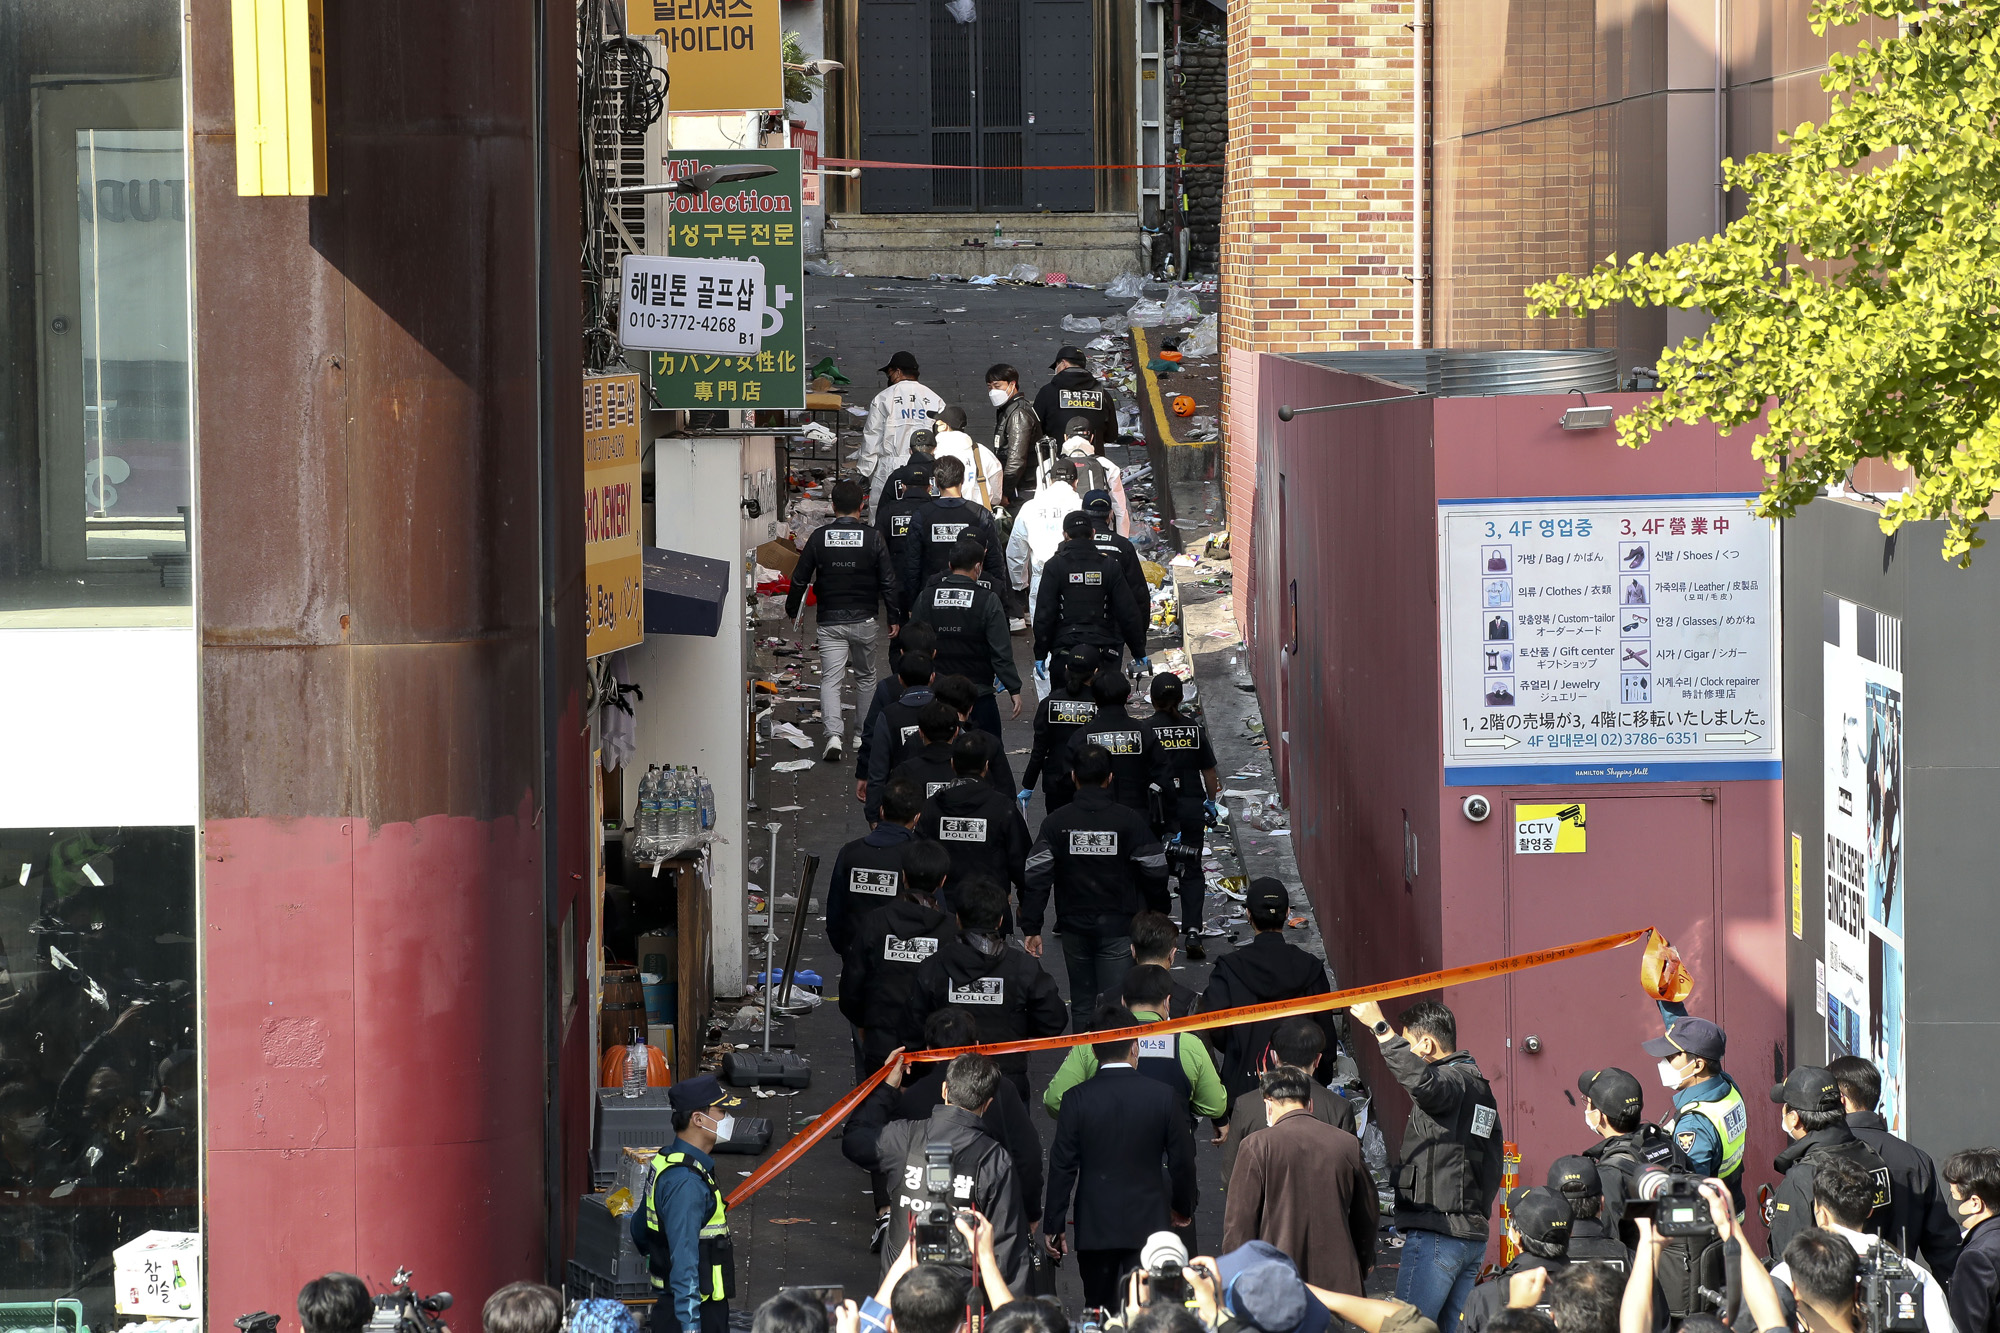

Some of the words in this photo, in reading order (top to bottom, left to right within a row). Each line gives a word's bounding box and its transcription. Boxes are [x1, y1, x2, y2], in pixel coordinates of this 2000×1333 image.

[655, 25, 754, 53] 아이디어
[631, 272, 687, 307] 해밀톤
[697, 276, 754, 312] 골프샵
[629, 312, 736, 333] 010-3772-4268
[739, 332, 754, 345] B1
[1062, 390, 1100, 401] 과학수사
[607, 380, 635, 429] 골프샵
[1067, 400, 1096, 408] POLICE
[901, 408, 926, 419] NFS
[600, 482, 631, 542] JEWERY
[1508, 520, 1533, 537] 4F
[1539, 518, 1593, 538] 영업중
[1641, 518, 1665, 535] 4F
[1517, 554, 1536, 565] 가방
[1545, 553, 1564, 565] Bag
[1573, 552, 1604, 562] かばん
[1655, 551, 1674, 562] 신발
[1683, 550, 1713, 560] Shoes
[1722, 550, 1740, 559] くつ
[1518, 586, 1537, 598] 의류
[1545, 586, 1582, 597] Clothes
[1591, 584, 1612, 595] 衣類
[1655, 582, 1686, 592] 가죽의류
[1694, 581, 1725, 592] Leather
[1732, 580, 1759, 591] 皮製品
[1518, 614, 1550, 625] 맞춤양복
[1557, 613, 1615, 624] Custom-tailor
[1655, 617, 1673, 627] 안경
[1682, 616, 1717, 626] Glasses
[1726, 615, 1756, 625] めがね
[1519, 647, 1550, 658] 토산품
[1560, 646, 1579, 656] Gift
[1581, 647, 1615, 656] center
[1656, 649, 1675, 660] 시가
[1684, 649, 1710, 661] Cigar
[1719, 648, 1747, 658] シガー
[1519, 680, 1550, 690] 쥬얼리
[1560, 679, 1601, 691] Jewelry
[1700, 676, 1724, 686] Clock
[1725, 677, 1760, 688] repairer
[1682, 689, 1736, 699] 時計修理店
[1052, 702, 1099, 713] 과학수사
[1092, 732, 1139, 744] 과학수사
[1527, 735, 1544, 747] 4F
[1547, 733, 1598, 748] 임대문의
[1601, 732, 1698, 746] 02)3786-6351
[1107, 744, 1133, 753] OLICE
[1519, 823, 1554, 834] CCTV
[1519, 838, 1554, 851] 촬영중
[1836, 838, 1847, 880] THE
[1847, 845, 1865, 892] SCENE
[856, 871, 894, 886] 경찰
[855, 884, 891, 893] POLICE
[1828, 874, 1847, 932] SINCE
[955, 994, 996, 1002] POLICE
[1140, 1040, 1166, 1050] 에스원
